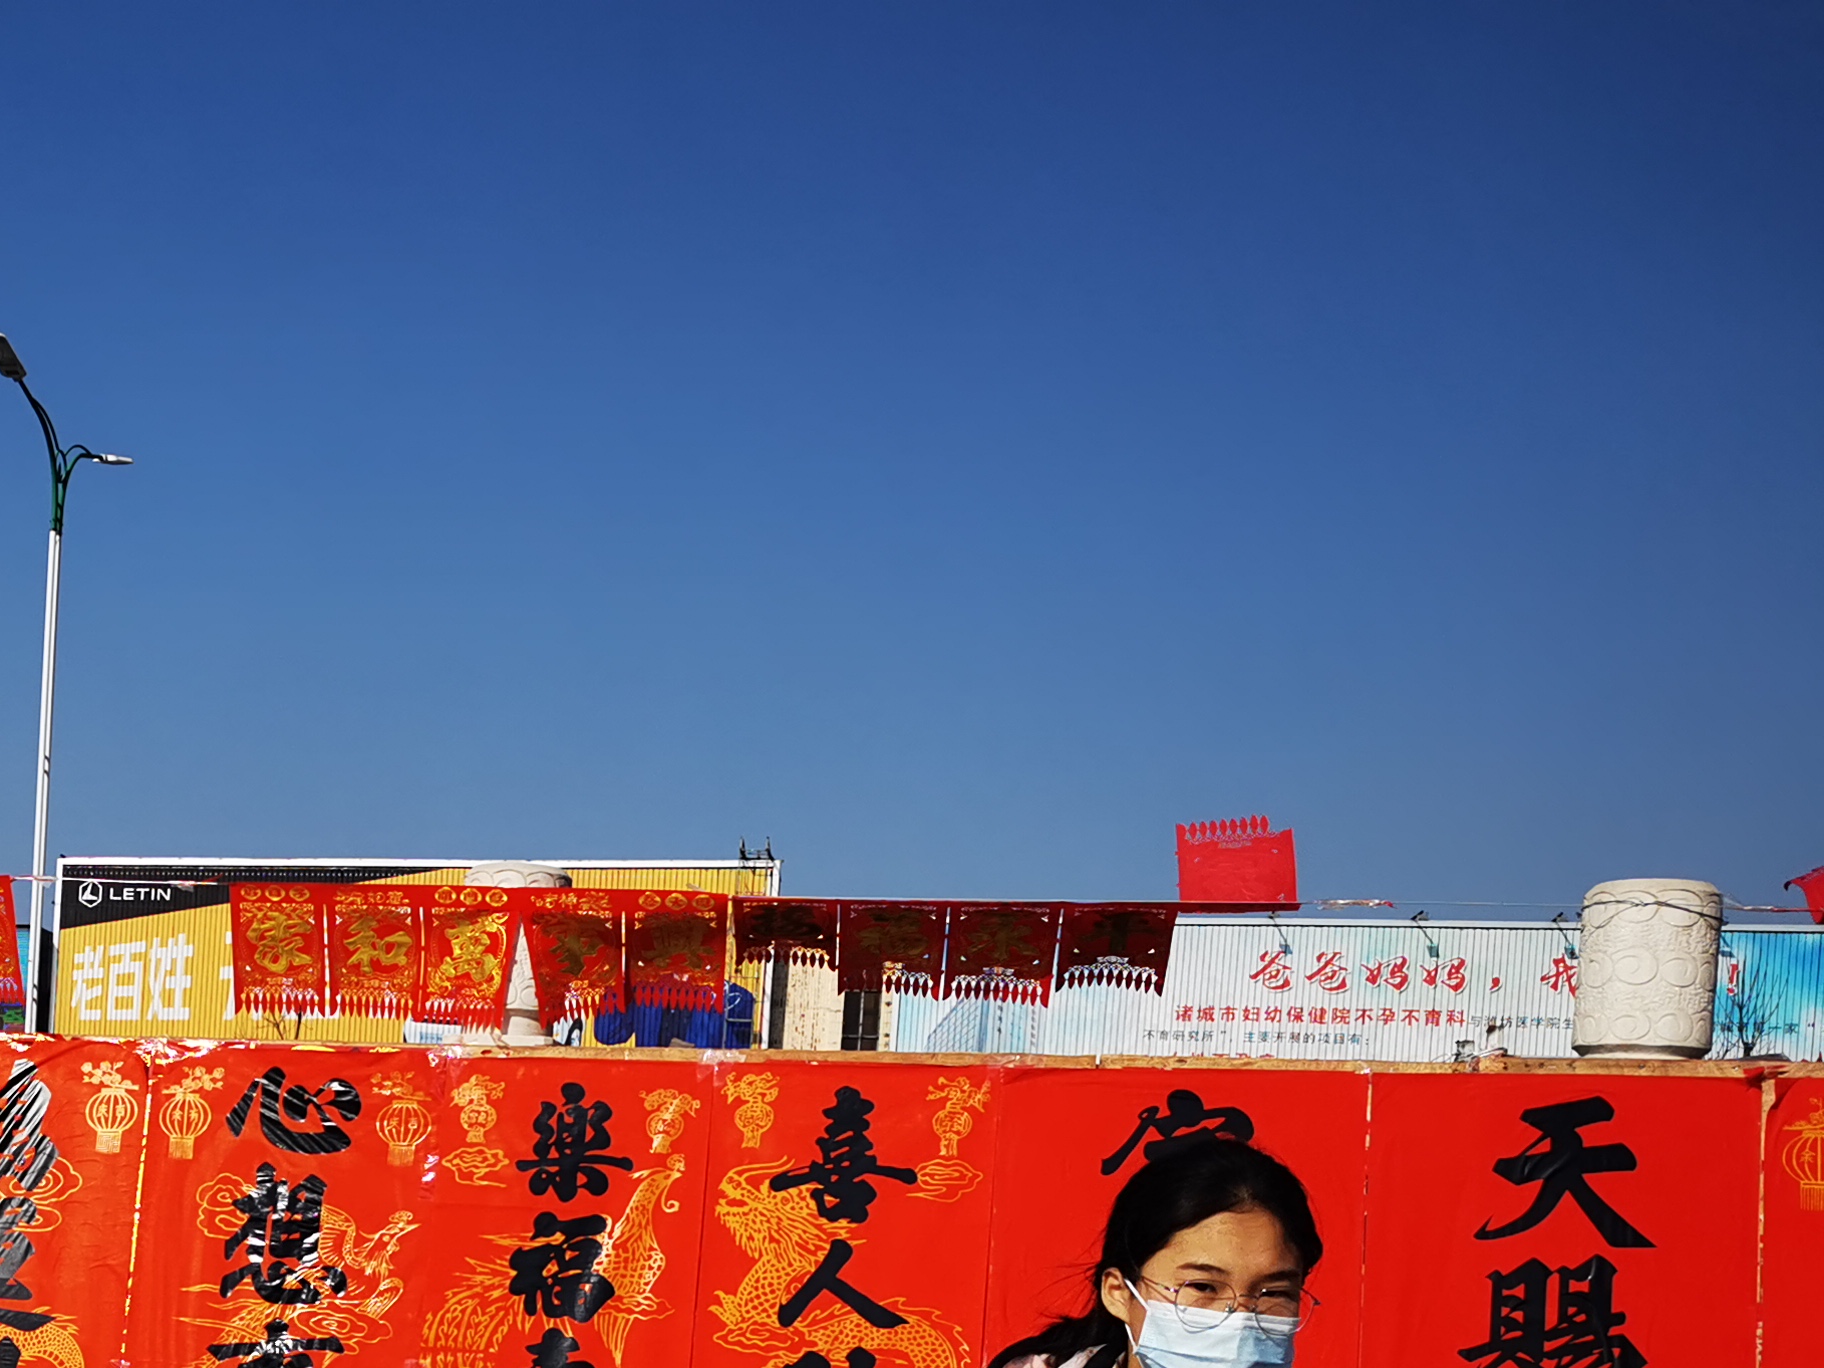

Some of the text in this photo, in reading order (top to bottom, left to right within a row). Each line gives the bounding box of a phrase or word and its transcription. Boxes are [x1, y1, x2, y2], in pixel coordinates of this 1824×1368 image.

[109, 888, 171, 901] LETIN
[70, 933, 194, 1021] 老百姓
